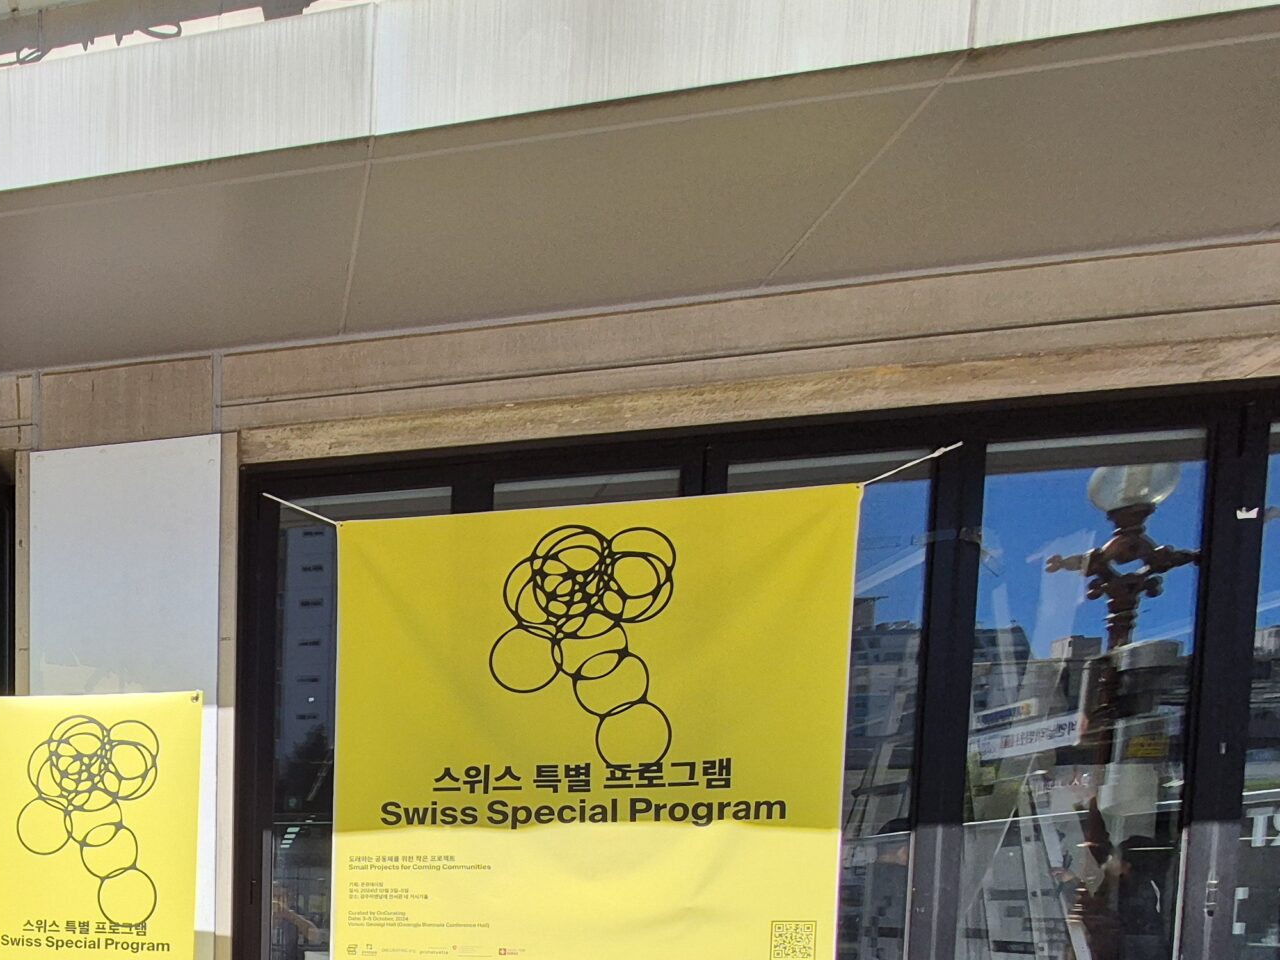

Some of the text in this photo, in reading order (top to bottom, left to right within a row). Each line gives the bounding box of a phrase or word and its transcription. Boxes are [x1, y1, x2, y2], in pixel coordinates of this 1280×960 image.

[432, 758, 732, 794] 스위스 특별 프로그램
[380, 797, 787, 829] Swiss Special Program
[22, 919, 147, 936] 스위스 특별 프로그램
[1, 935, 170, 952] Swiss Special Program
